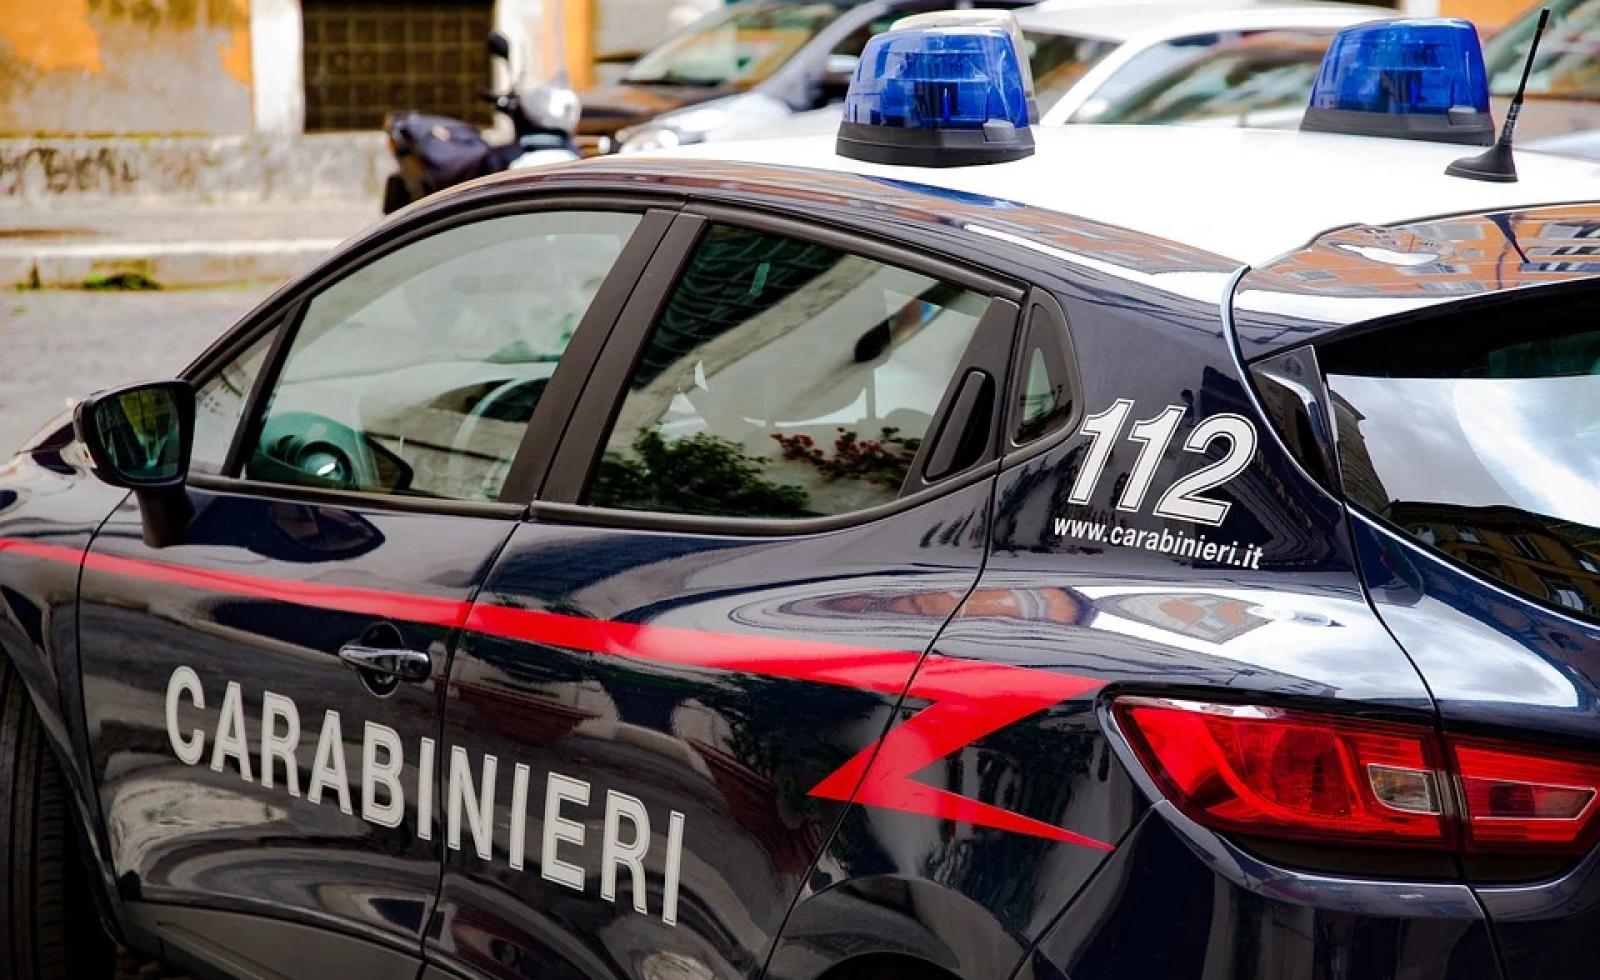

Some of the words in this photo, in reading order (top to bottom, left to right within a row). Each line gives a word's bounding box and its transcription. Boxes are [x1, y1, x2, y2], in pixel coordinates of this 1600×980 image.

[1068, 398, 1258, 527] 112
[1054, 517, 1263, 569] www.carabinieri.it
[165, 665, 685, 926] CARABINIERI
